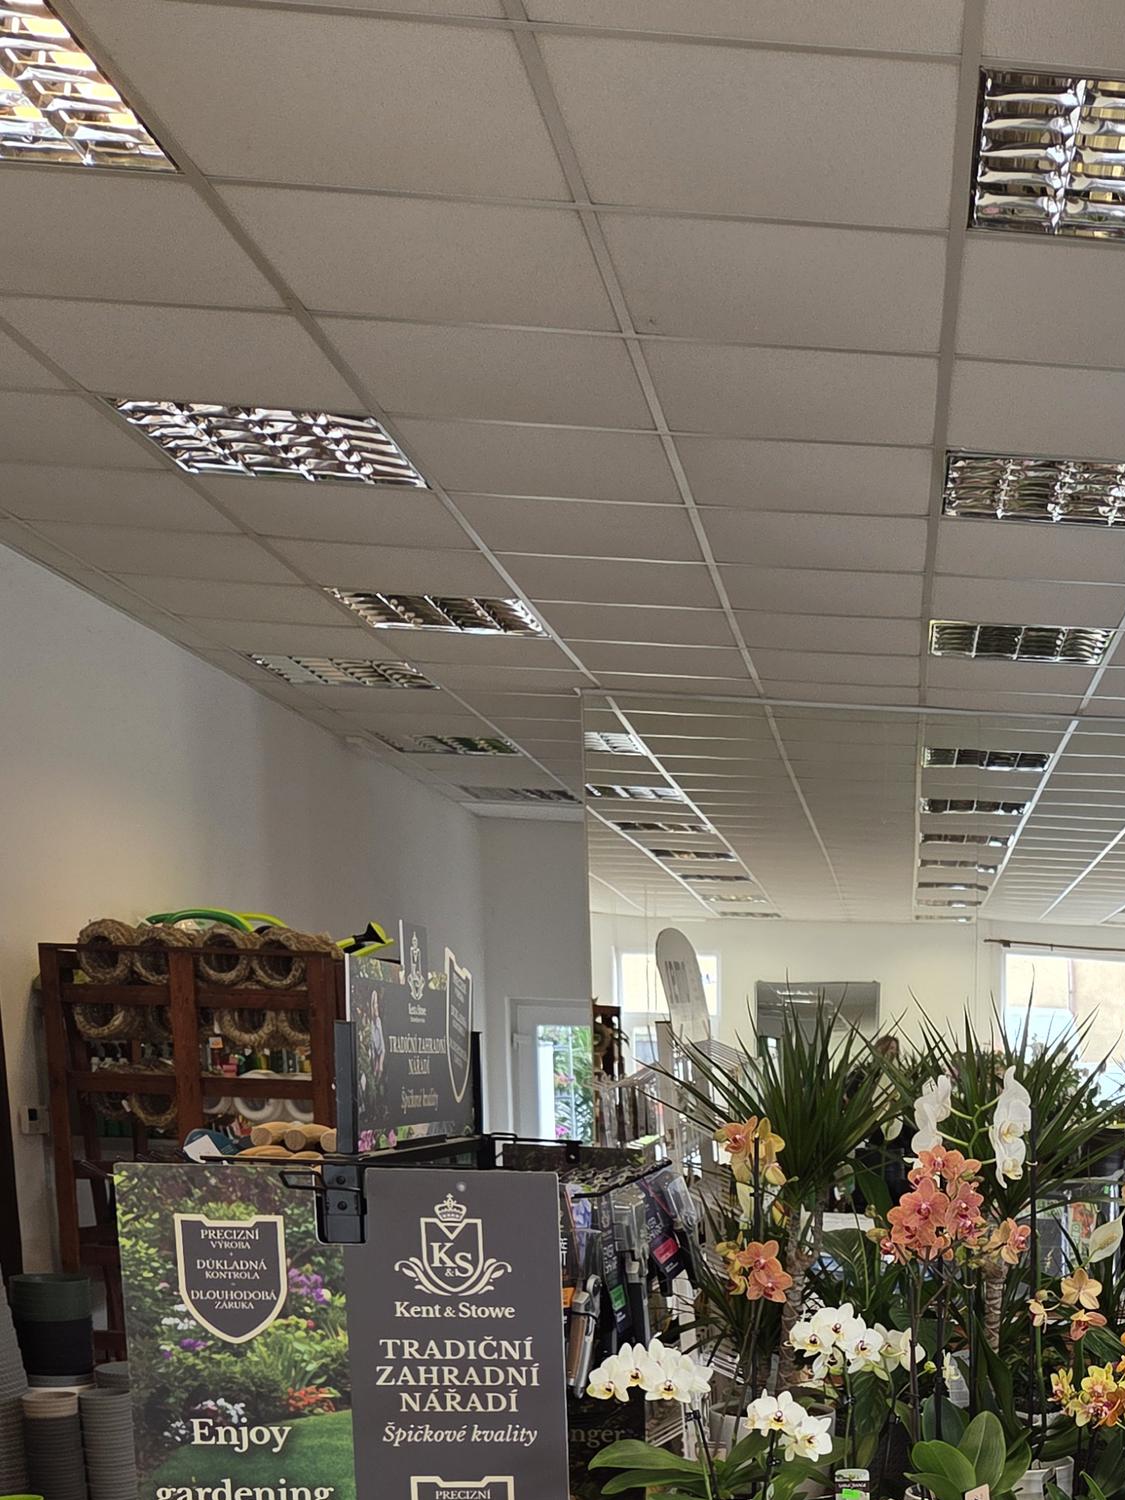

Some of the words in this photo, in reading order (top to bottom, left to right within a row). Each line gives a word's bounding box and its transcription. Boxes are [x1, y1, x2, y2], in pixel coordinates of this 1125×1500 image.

[200, 1228, 260, 1240] PRECIZNÍ
[210, 1240, 251, 1249] VÝROBA
[196, 1258, 268, 1270] DŮKLADNÁ
[205, 1270, 260, 1279] KONTROLA
[190, 1289, 277, 1301] DLOUHODOBÁ
[214, 1301, 255, 1309] ZÁRUKA
[394, 1301, 441, 1318] Kent
[443, 1306, 456, 1318] &
[458, 1302, 516, 1318] Stowe
[379, 1336, 534, 1360] TRADIČNÍ
[375, 1363, 541, 1386] ZAHRADNÍ
[399, 1388, 519, 1412] NÁŘADÍ
[190, 1416, 292, 1453] Enjoy
[382, 1421, 467, 1447] Špičkové
[471, 1424, 538, 1447] kvality
[435, 1488, 491, 1500] PRECIZNÍ
